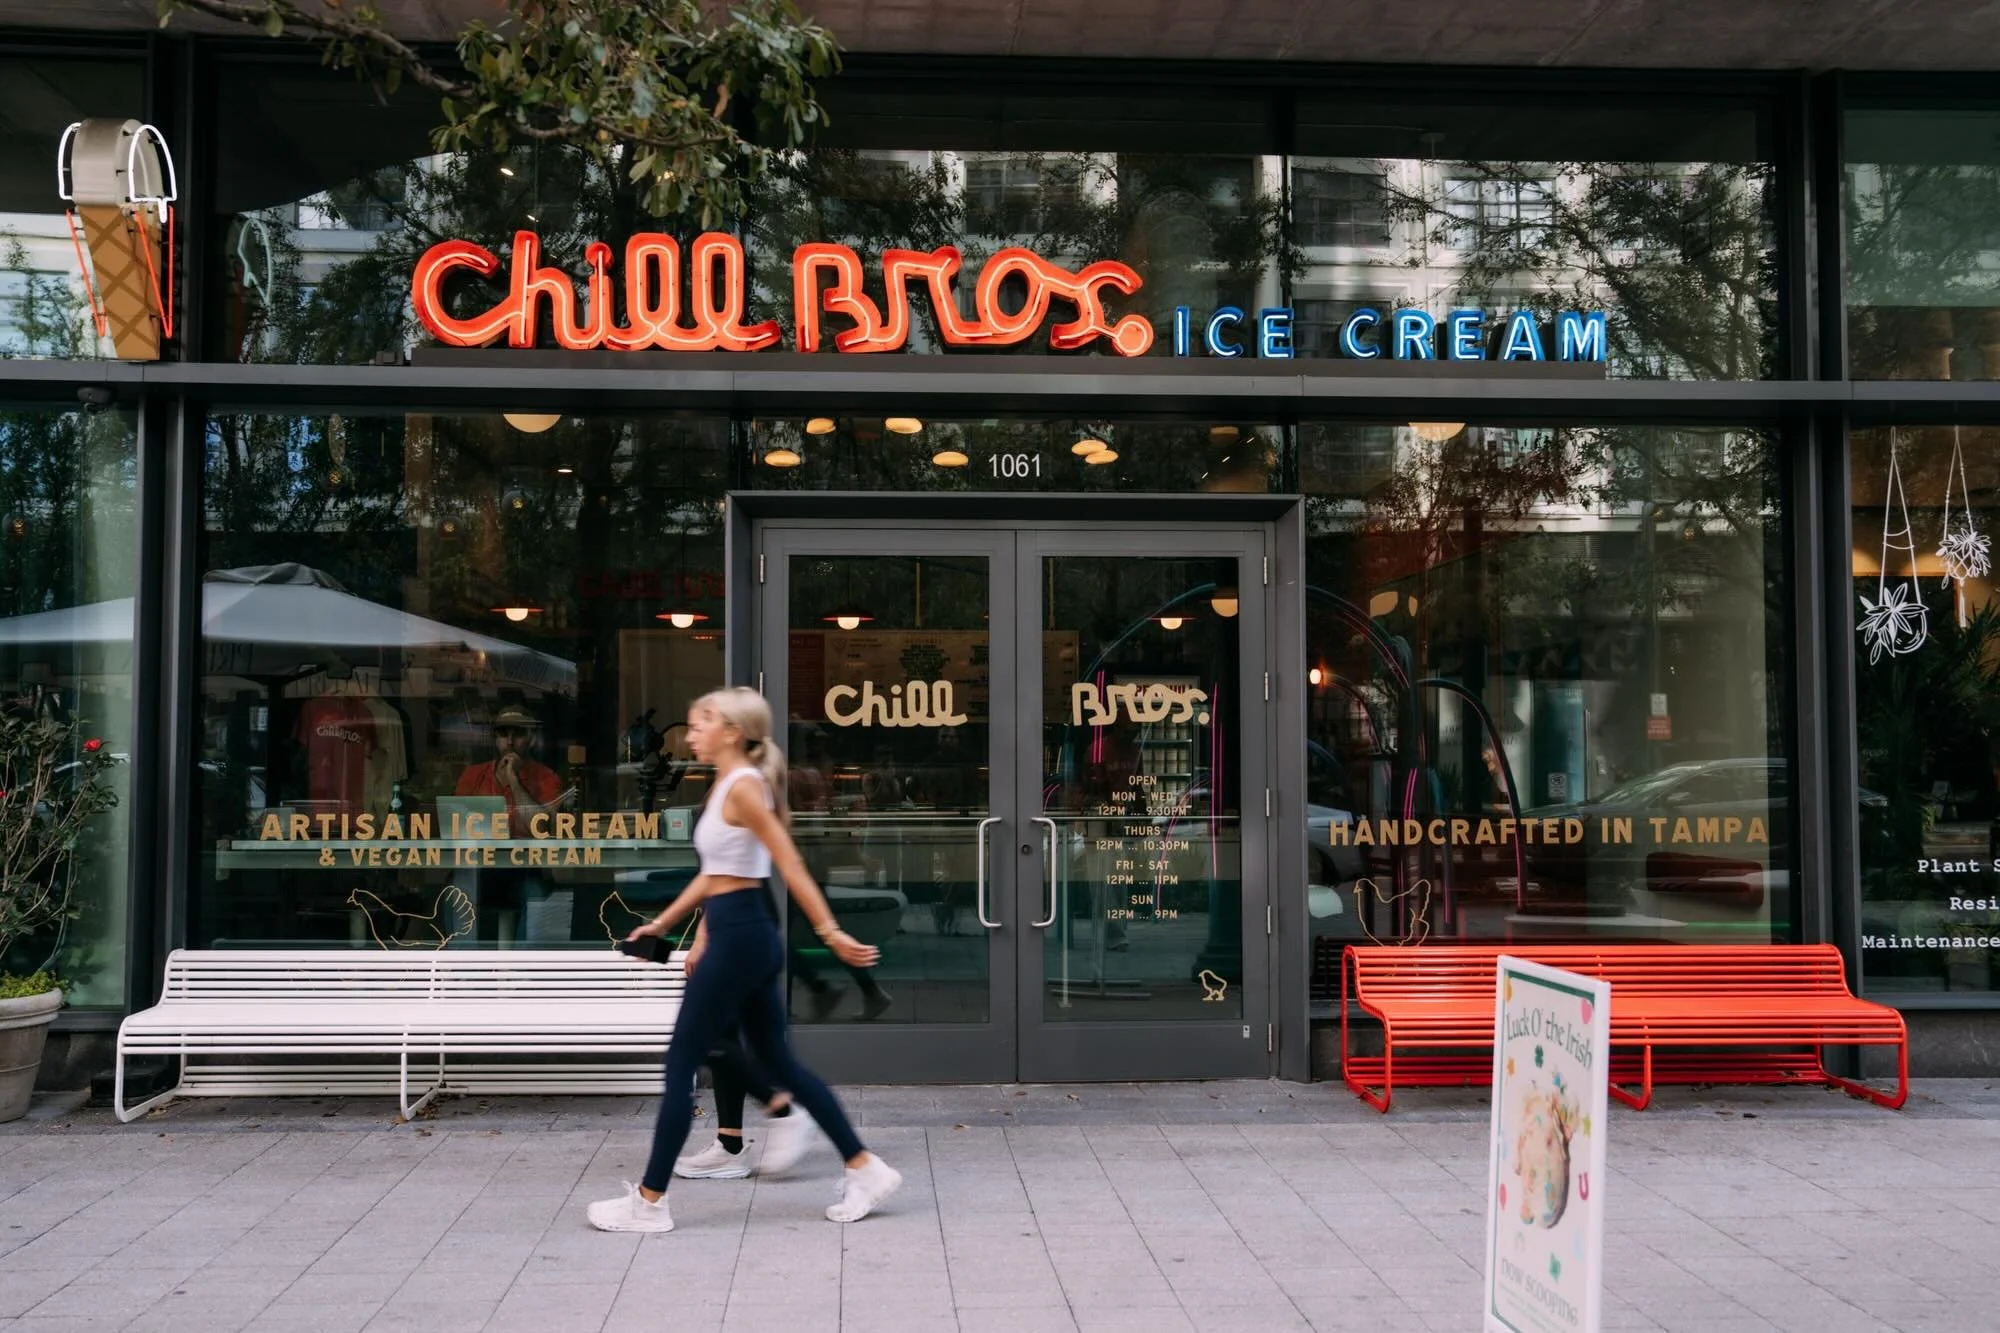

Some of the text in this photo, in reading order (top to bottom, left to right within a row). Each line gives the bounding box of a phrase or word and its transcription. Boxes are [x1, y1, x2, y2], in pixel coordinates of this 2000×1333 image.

[411, 230, 1154, 357] Chill Bros.
[1173, 306, 1607, 361] ICE CREAM
[988, 453, 1041, 477] 1061
[824, 680, 1210, 727] Chill Bros.
[1128, 775, 1158, 786] OPEN
[1112, 791, 1136, 801] MON
[1150, 791, 1173, 801] WED
[1098, 806, 1126, 816] 12PM
[1146, 806, 1187, 816] 9:30PM
[260, 812, 660, 841] ARTISAN ICE CREAM
[1124, 825, 1161, 836] THURS
[1328, 815, 1769, 846] HANDCRAFTED IN TAMPA
[1096, 840, 1123, 850] 12PM
[1143, 840, 1189, 850] 10:30PM
[319, 847, 602, 867] & VEGAN ICE CREAM
[1116, 860, 1134, 870] FRI
[1148, 860, 1169, 870] SAT
[1917, 858, 1981, 873] Plant
[1106, 875, 1134, 885] 12PM
[1154, 875, 1178, 885] 11PM
[1131, 895, 1154, 905] SUN
[1949, 896, 2000, 910] Resi
[1107, 909, 1134, 919] 12PM
[1155, 909, 1178, 919] 9PM
[1861, 934, 2000, 949] Maintenance
[1506, 1007, 1530, 1041] Luck
[1545, 1011, 1565, 1047] the
[1565, 1022, 1593, 1072] Irish
